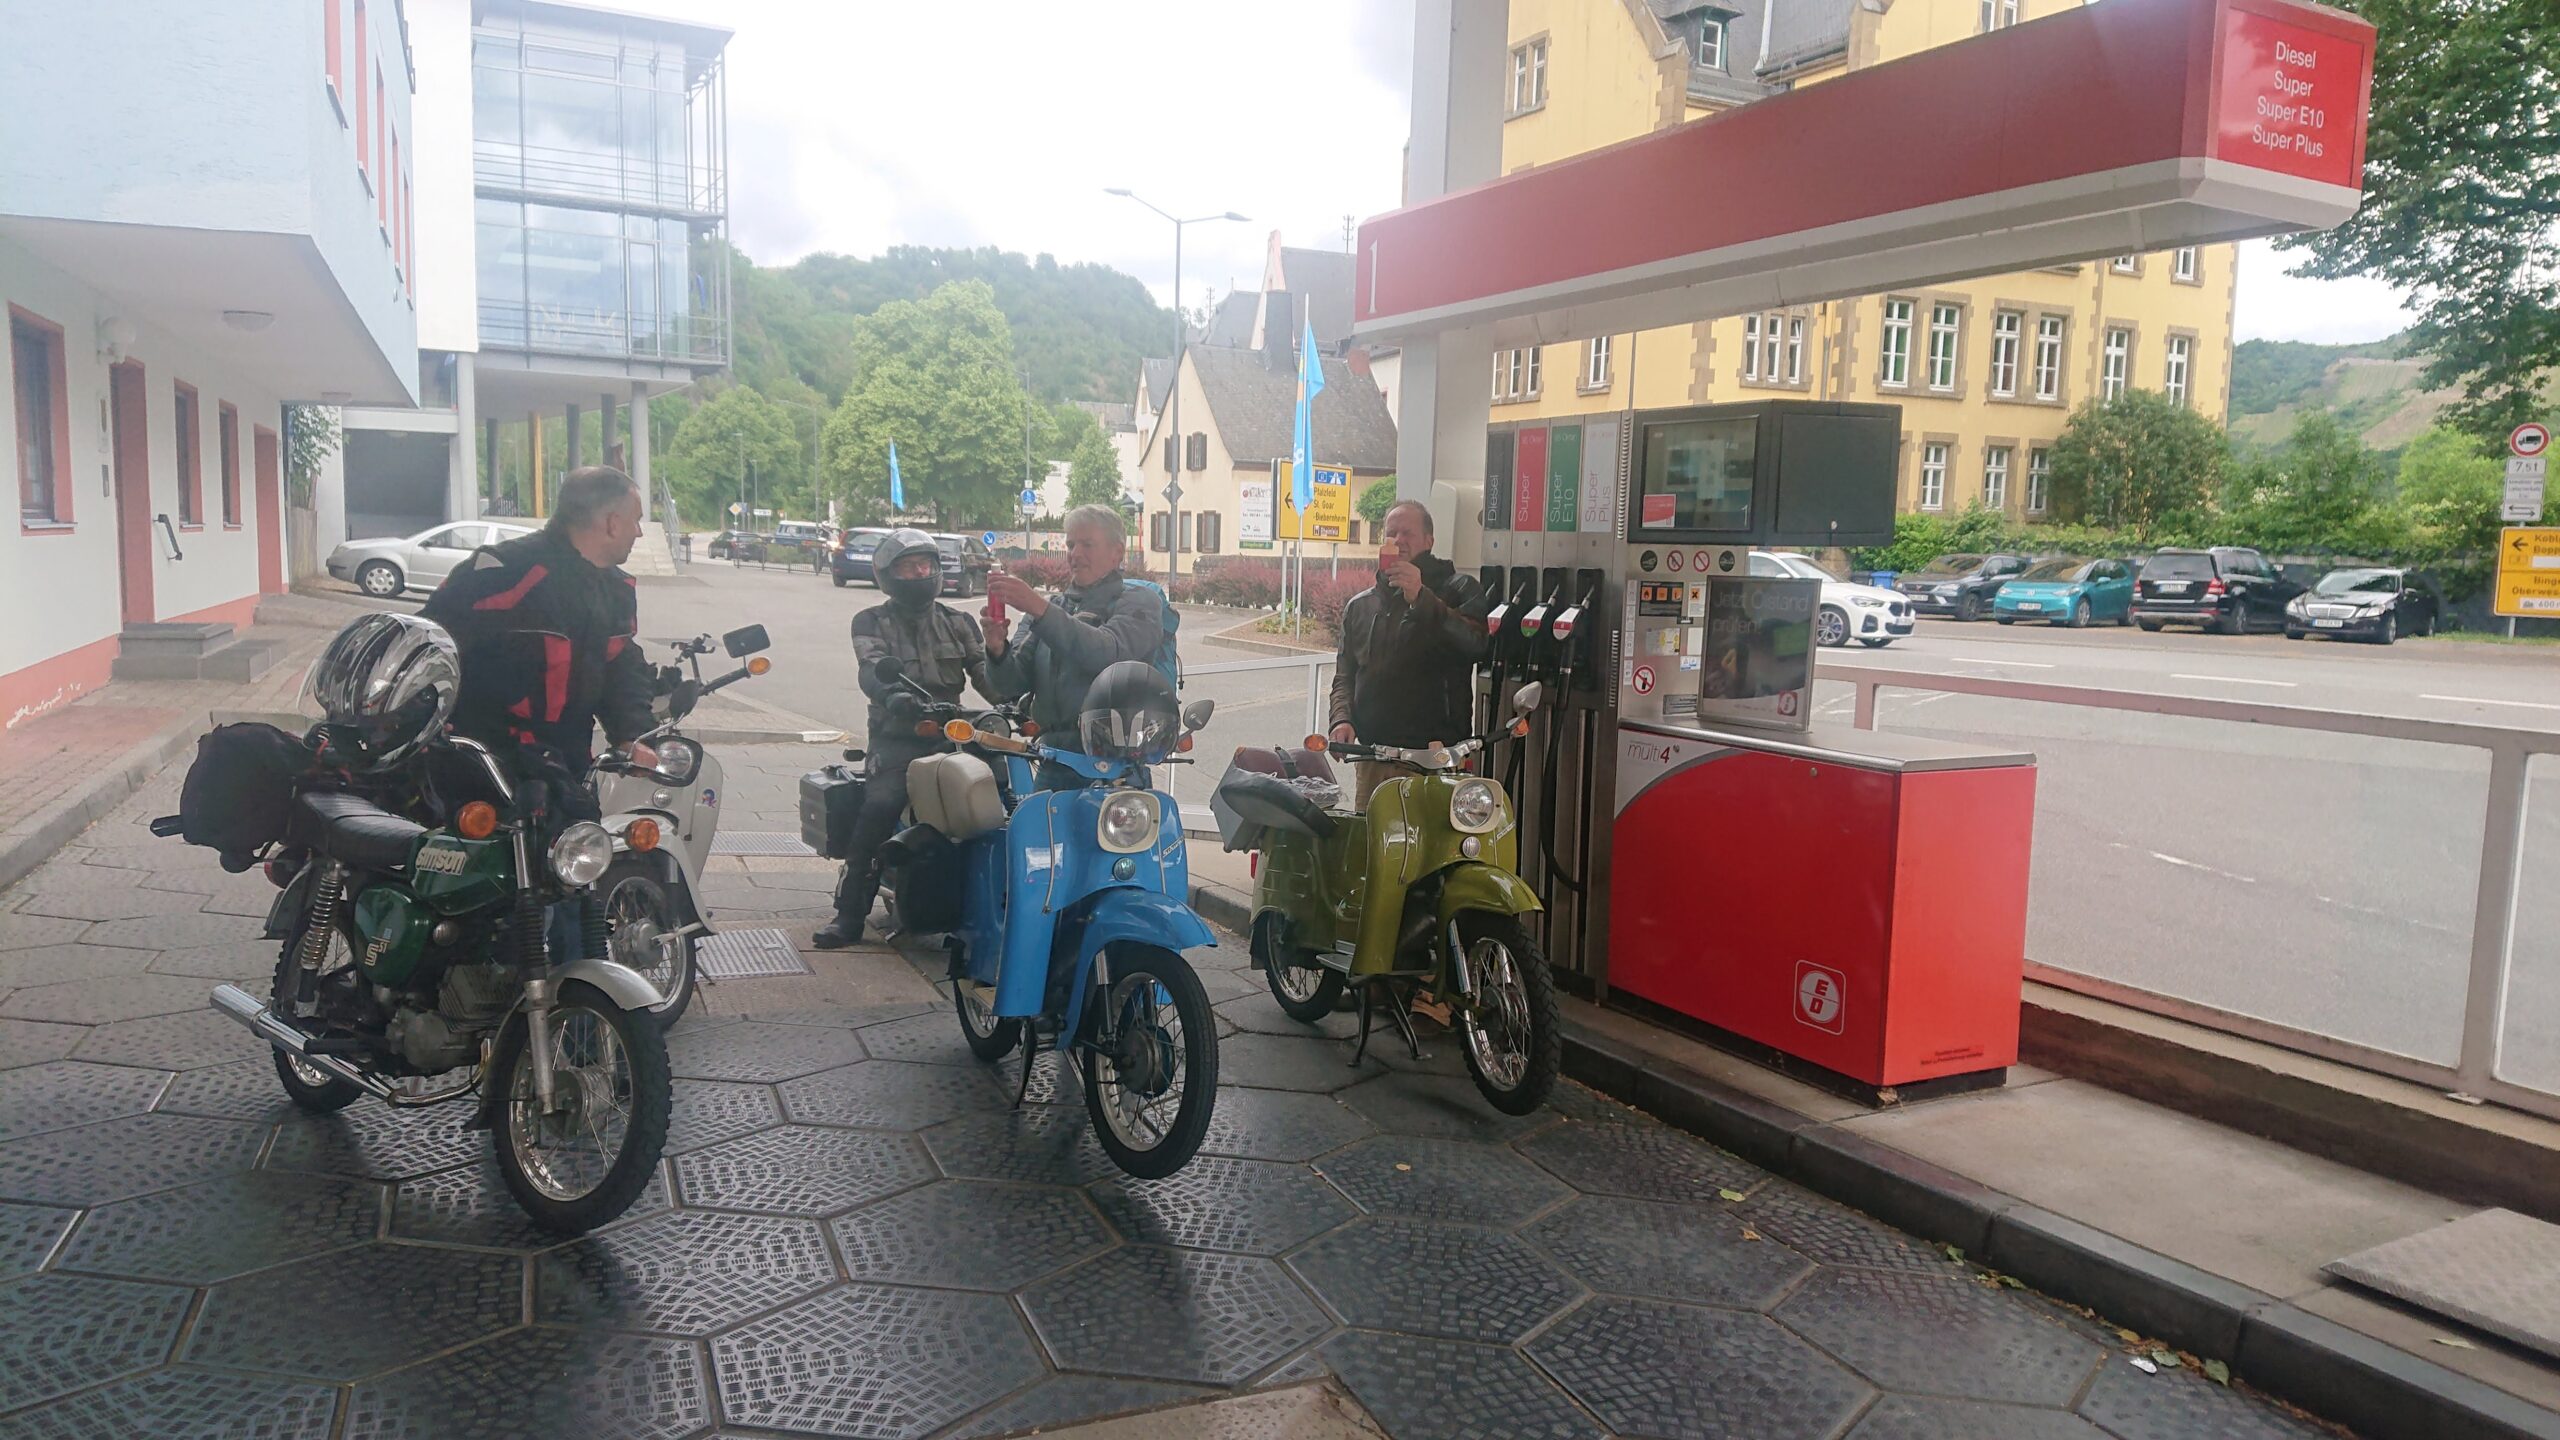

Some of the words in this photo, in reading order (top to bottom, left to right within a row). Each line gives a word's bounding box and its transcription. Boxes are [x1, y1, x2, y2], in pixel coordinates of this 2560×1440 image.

[2275, 41, 2317, 69] Diesel
[2273, 70, 2314, 97] Super
[2256, 95, 2297, 122] Super
[2299, 105, 2324, 129] E10
[2252, 124, 2293, 151] Super
[2295, 133, 2324, 157] Plus
[1368, 239, 1378, 314] 1
[1322, 501, 1335, 510] Goar
[1487, 474, 1500, 522] Diesel
[1518, 472, 1531, 523] Super
[1549, 472, 1563, 524] Super
[1562, 487, 1576, 523] E10
[1585, 470, 1599, 523] Super
[1598, 486, 1612, 523] Plus
[1741, 504, 1749, 527] 1
[2533, 534, 2560, 543] Kobl
[2511, 586, 2560, 597] Oberwes
